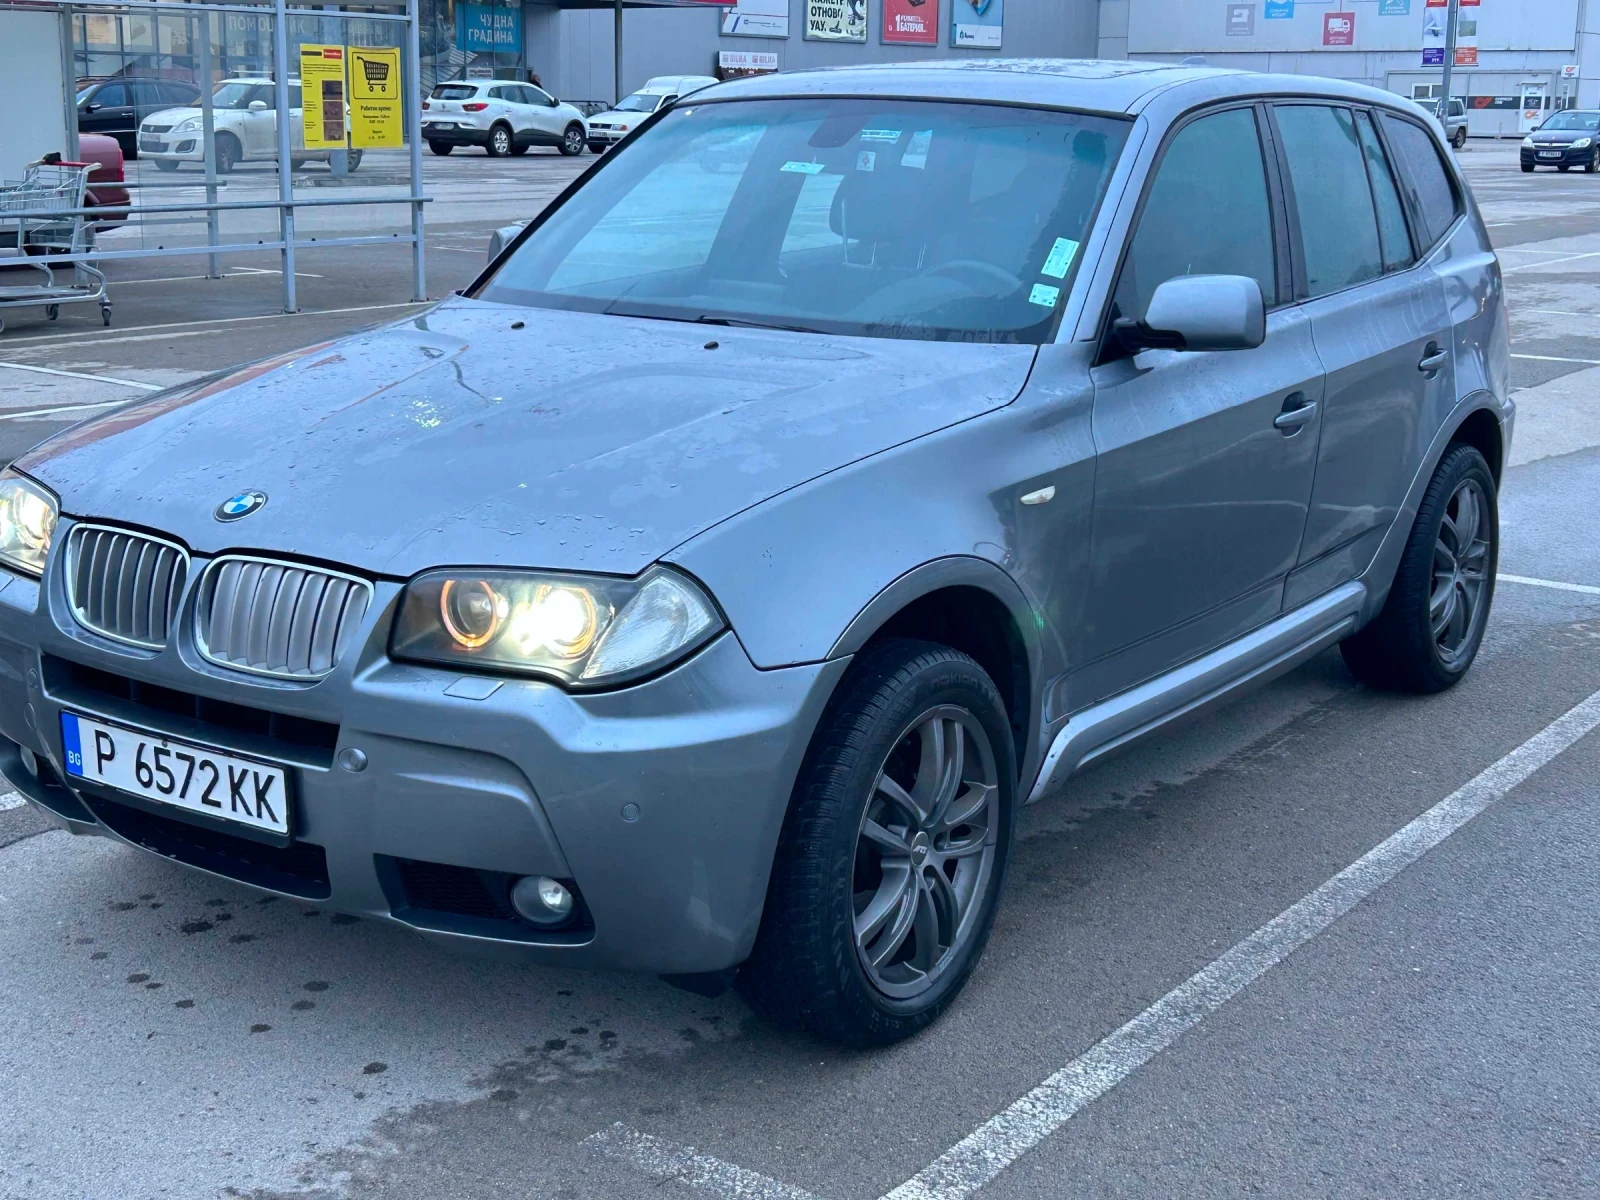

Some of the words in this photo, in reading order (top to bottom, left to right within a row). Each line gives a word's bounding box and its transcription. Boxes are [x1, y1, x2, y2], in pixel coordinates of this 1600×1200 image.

[810, 6, 843, 19] ОТНОВО
[480, 14, 514, 29] ЧУДНА
[810, 20, 827, 31] УАУ.
[468, 29, 514, 44] ГРАДИНА
[729, 54, 747, 63] BILKA
[758, 55, 776, 64] BILKA
[68, 750, 81, 766] BG
